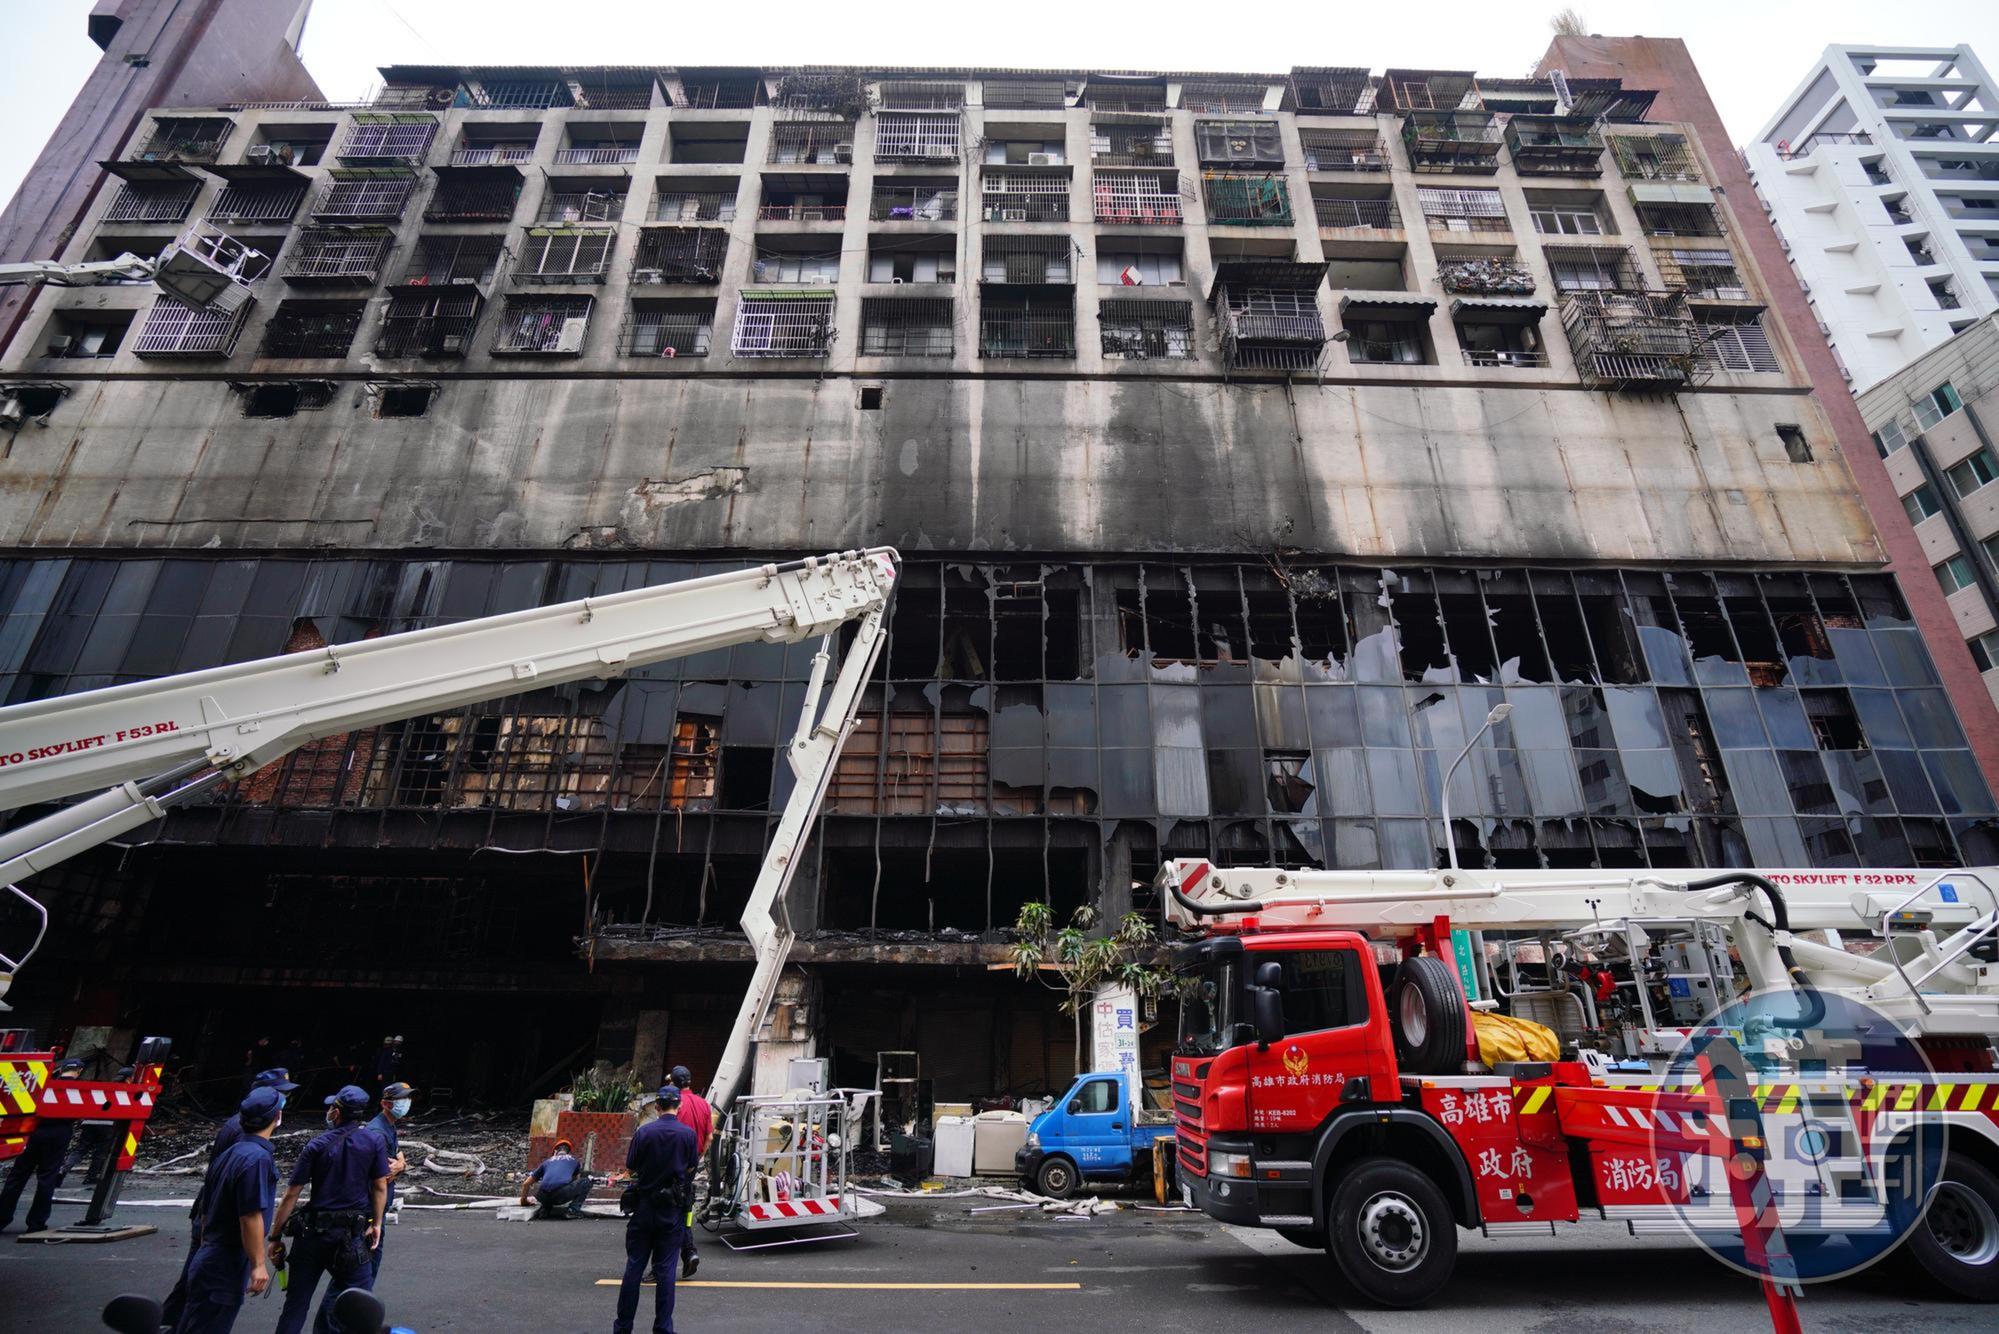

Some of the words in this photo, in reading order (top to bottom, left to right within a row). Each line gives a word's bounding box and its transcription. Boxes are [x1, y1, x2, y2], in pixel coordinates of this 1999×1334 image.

[28, 735, 106, 761] SKYLIFT
[115, 730, 127, 743] F
[130, 725, 153, 740] 53
[155, 721, 179, 734] RL
[1793, 874, 1847, 885] SKYLIFT
[1864, 874, 1881, 885] 32
[1251, 1073, 1346, 1088] 高雄市政府消防局
[1439, 1091, 1512, 1126] 高雄市
[1478, 1147, 1534, 1180] 政府
[1602, 1157, 1679, 1192] 消防局
